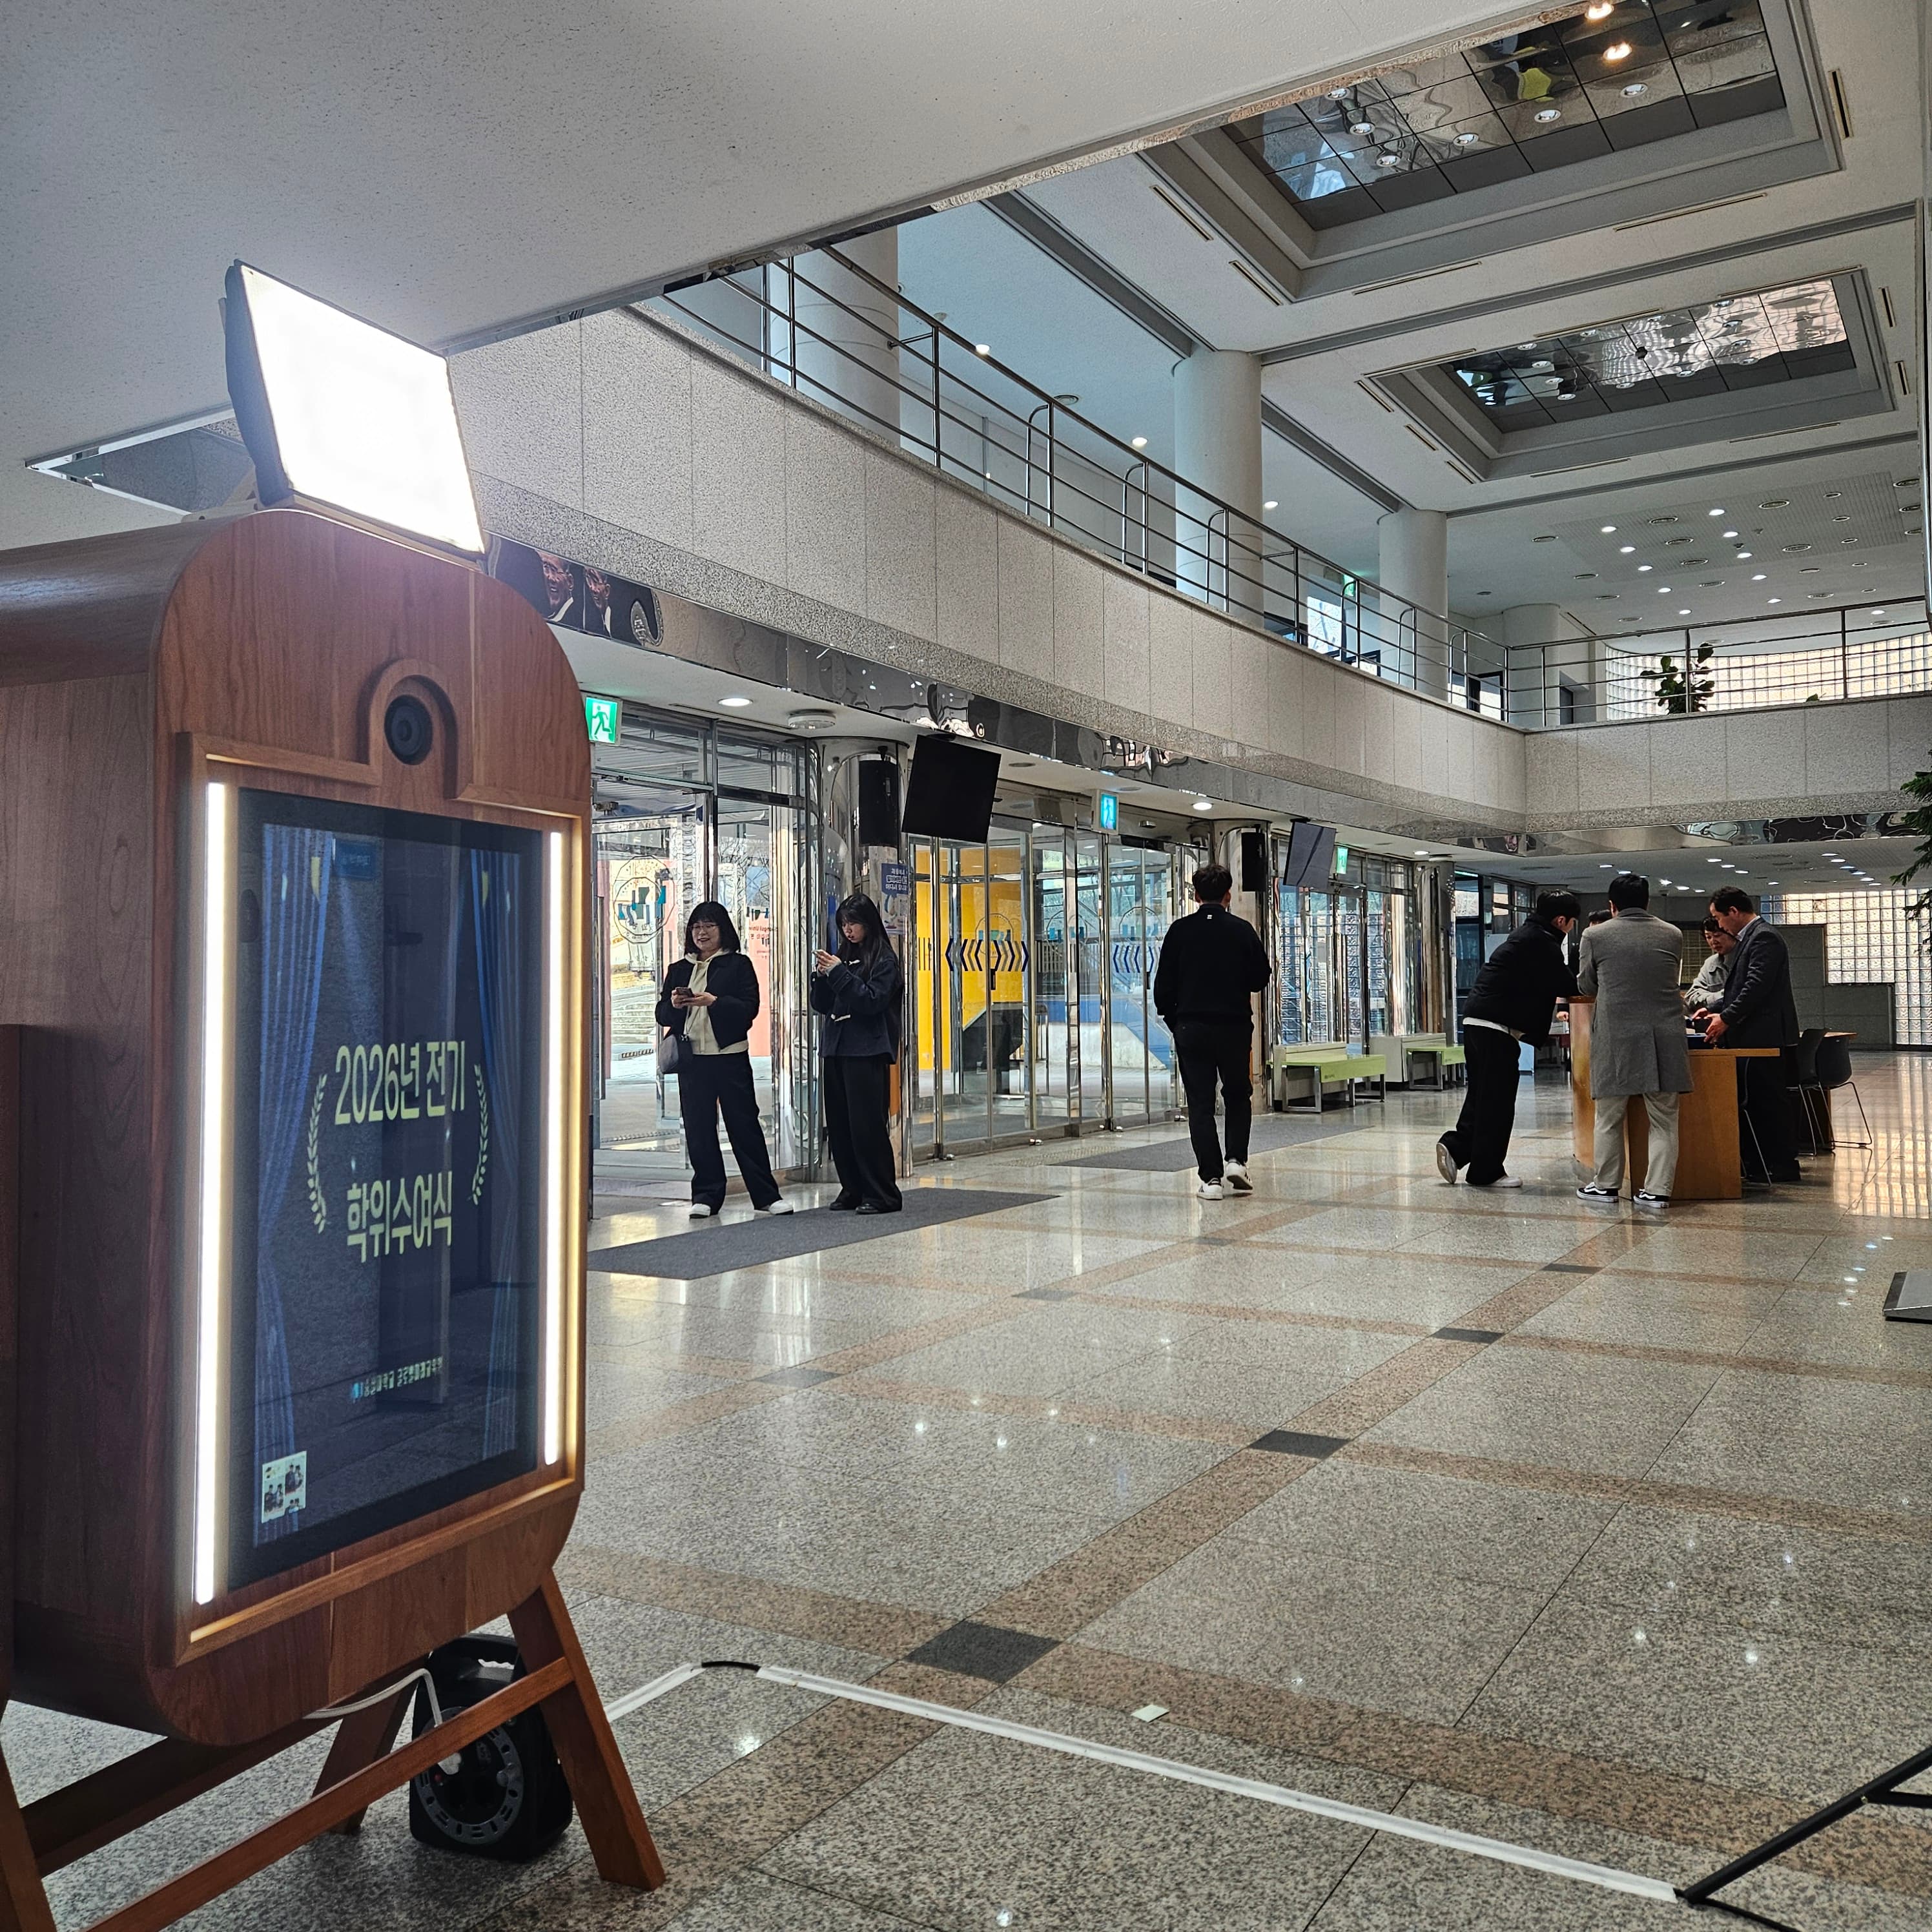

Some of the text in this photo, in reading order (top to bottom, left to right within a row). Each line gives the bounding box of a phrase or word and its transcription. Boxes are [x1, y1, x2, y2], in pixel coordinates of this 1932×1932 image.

[334, 1040, 466, 1125] 2026년 전기
[347, 1171, 453, 1263] 학위수여식
